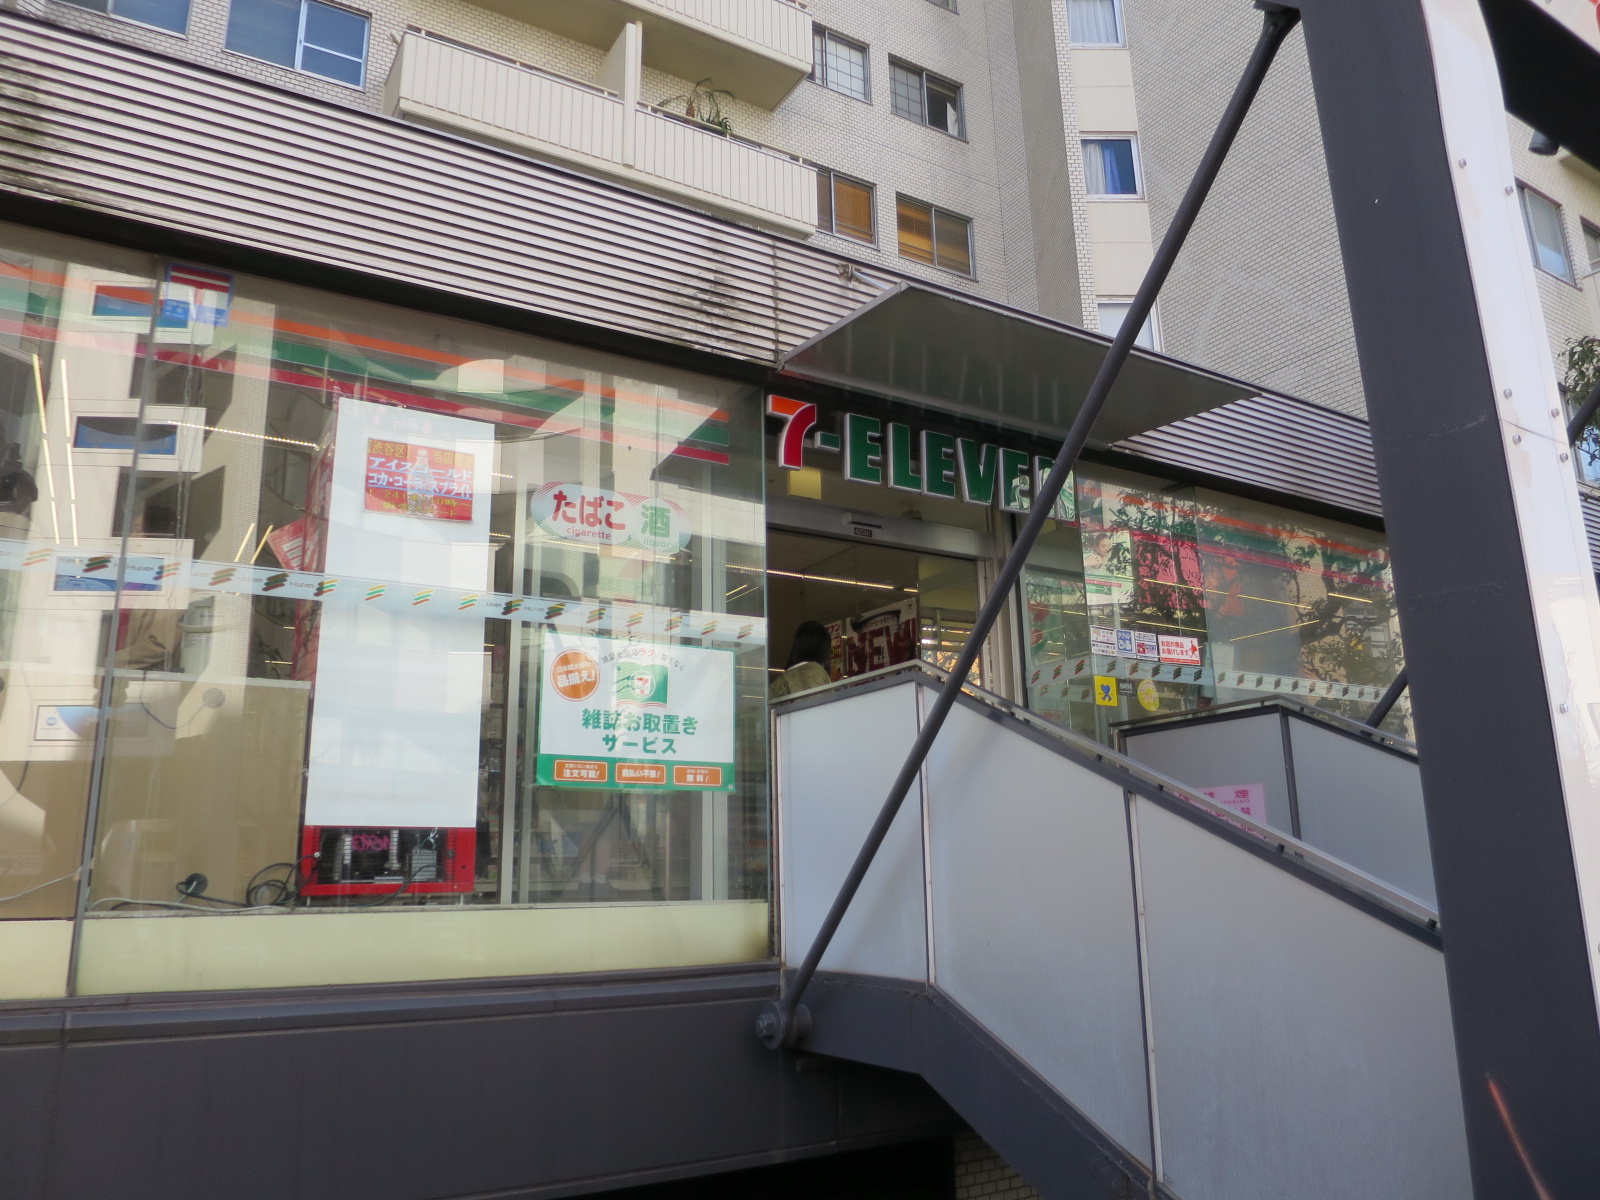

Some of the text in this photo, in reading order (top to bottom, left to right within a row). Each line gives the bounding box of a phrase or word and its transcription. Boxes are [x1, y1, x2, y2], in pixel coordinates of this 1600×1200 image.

[368, 456, 472, 480] アイスコールド
[552, 490, 671, 538] たばこ 酒
[567, 526, 672, 549] cigarette liquor
[557, 669, 596, 688] 品揃え!
[581, 707, 698, 736] 雑誌お取置き
[602, 733, 677, 755] サービス
[562, 768, 600, 779] 注文可能!
[621, 768, 661, 779] 前払い不要!
